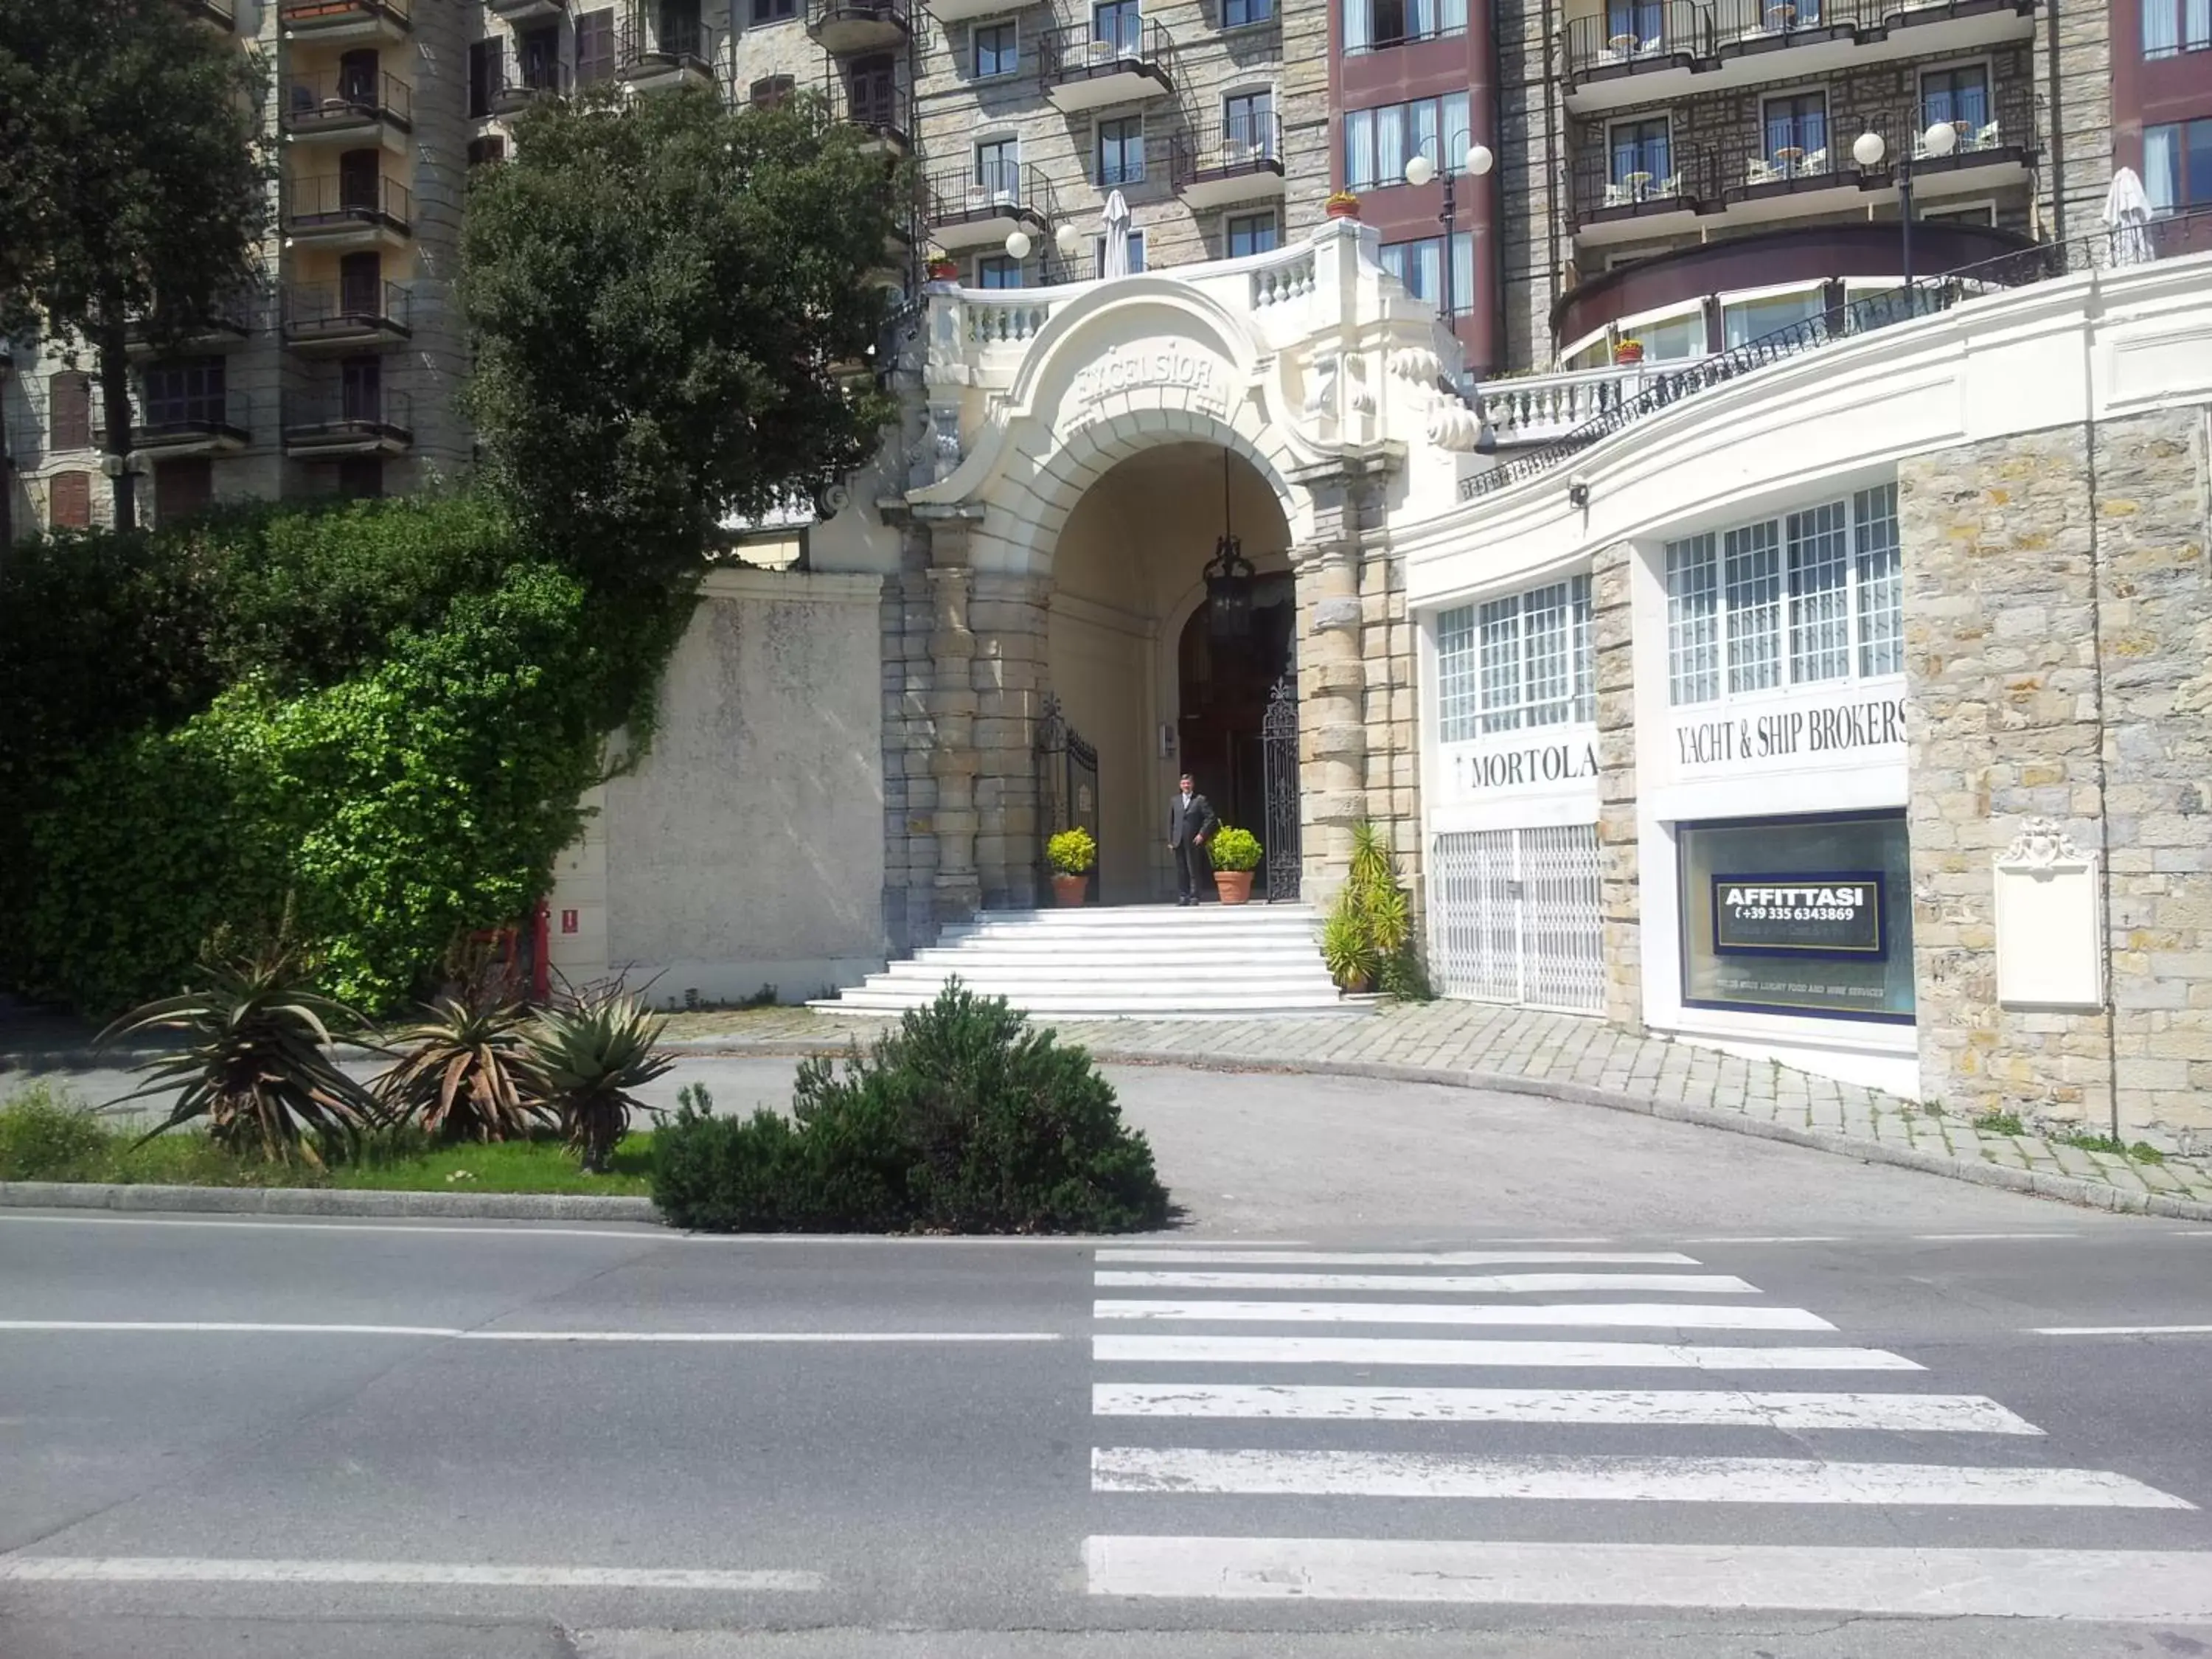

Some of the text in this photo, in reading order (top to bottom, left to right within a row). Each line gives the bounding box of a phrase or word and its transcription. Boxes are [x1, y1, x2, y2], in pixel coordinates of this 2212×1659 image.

[1075, 354, 1213, 403] EXCELSIOR
[1676, 698, 1908, 765] YACHT & SHIP BROKERS
[1472, 742, 1599, 788] MORTOLA
[1725, 887, 1864, 907] AFFITTASI
[1767, 907, 1792, 920] 335
[1793, 908, 1854, 921] 6343869
